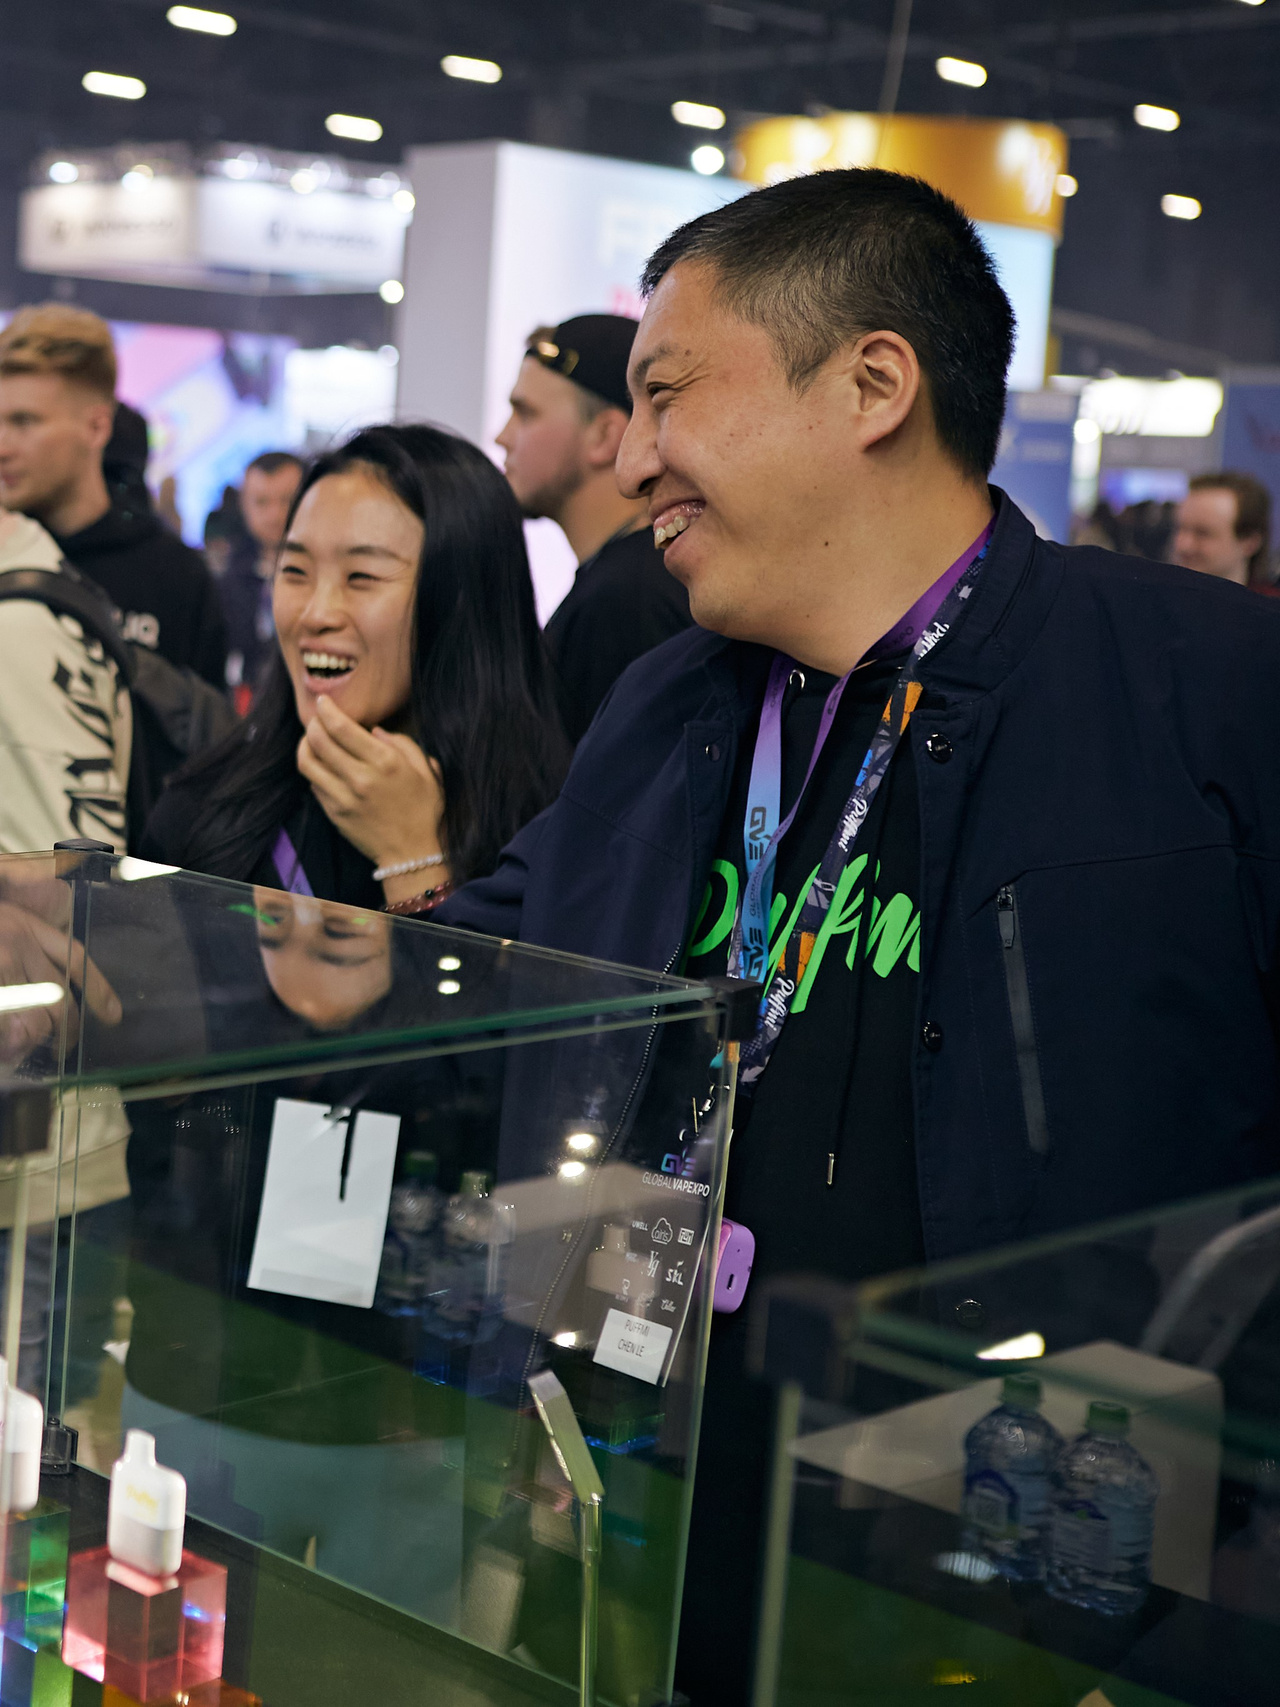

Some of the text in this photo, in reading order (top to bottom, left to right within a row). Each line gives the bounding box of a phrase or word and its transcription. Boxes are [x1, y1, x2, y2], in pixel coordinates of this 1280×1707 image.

[764, 976, 795, 1031] Puffmi
[624, 1319, 651, 1337] PUFFMI
[618, 1338, 645, 1357] CHEN LE
